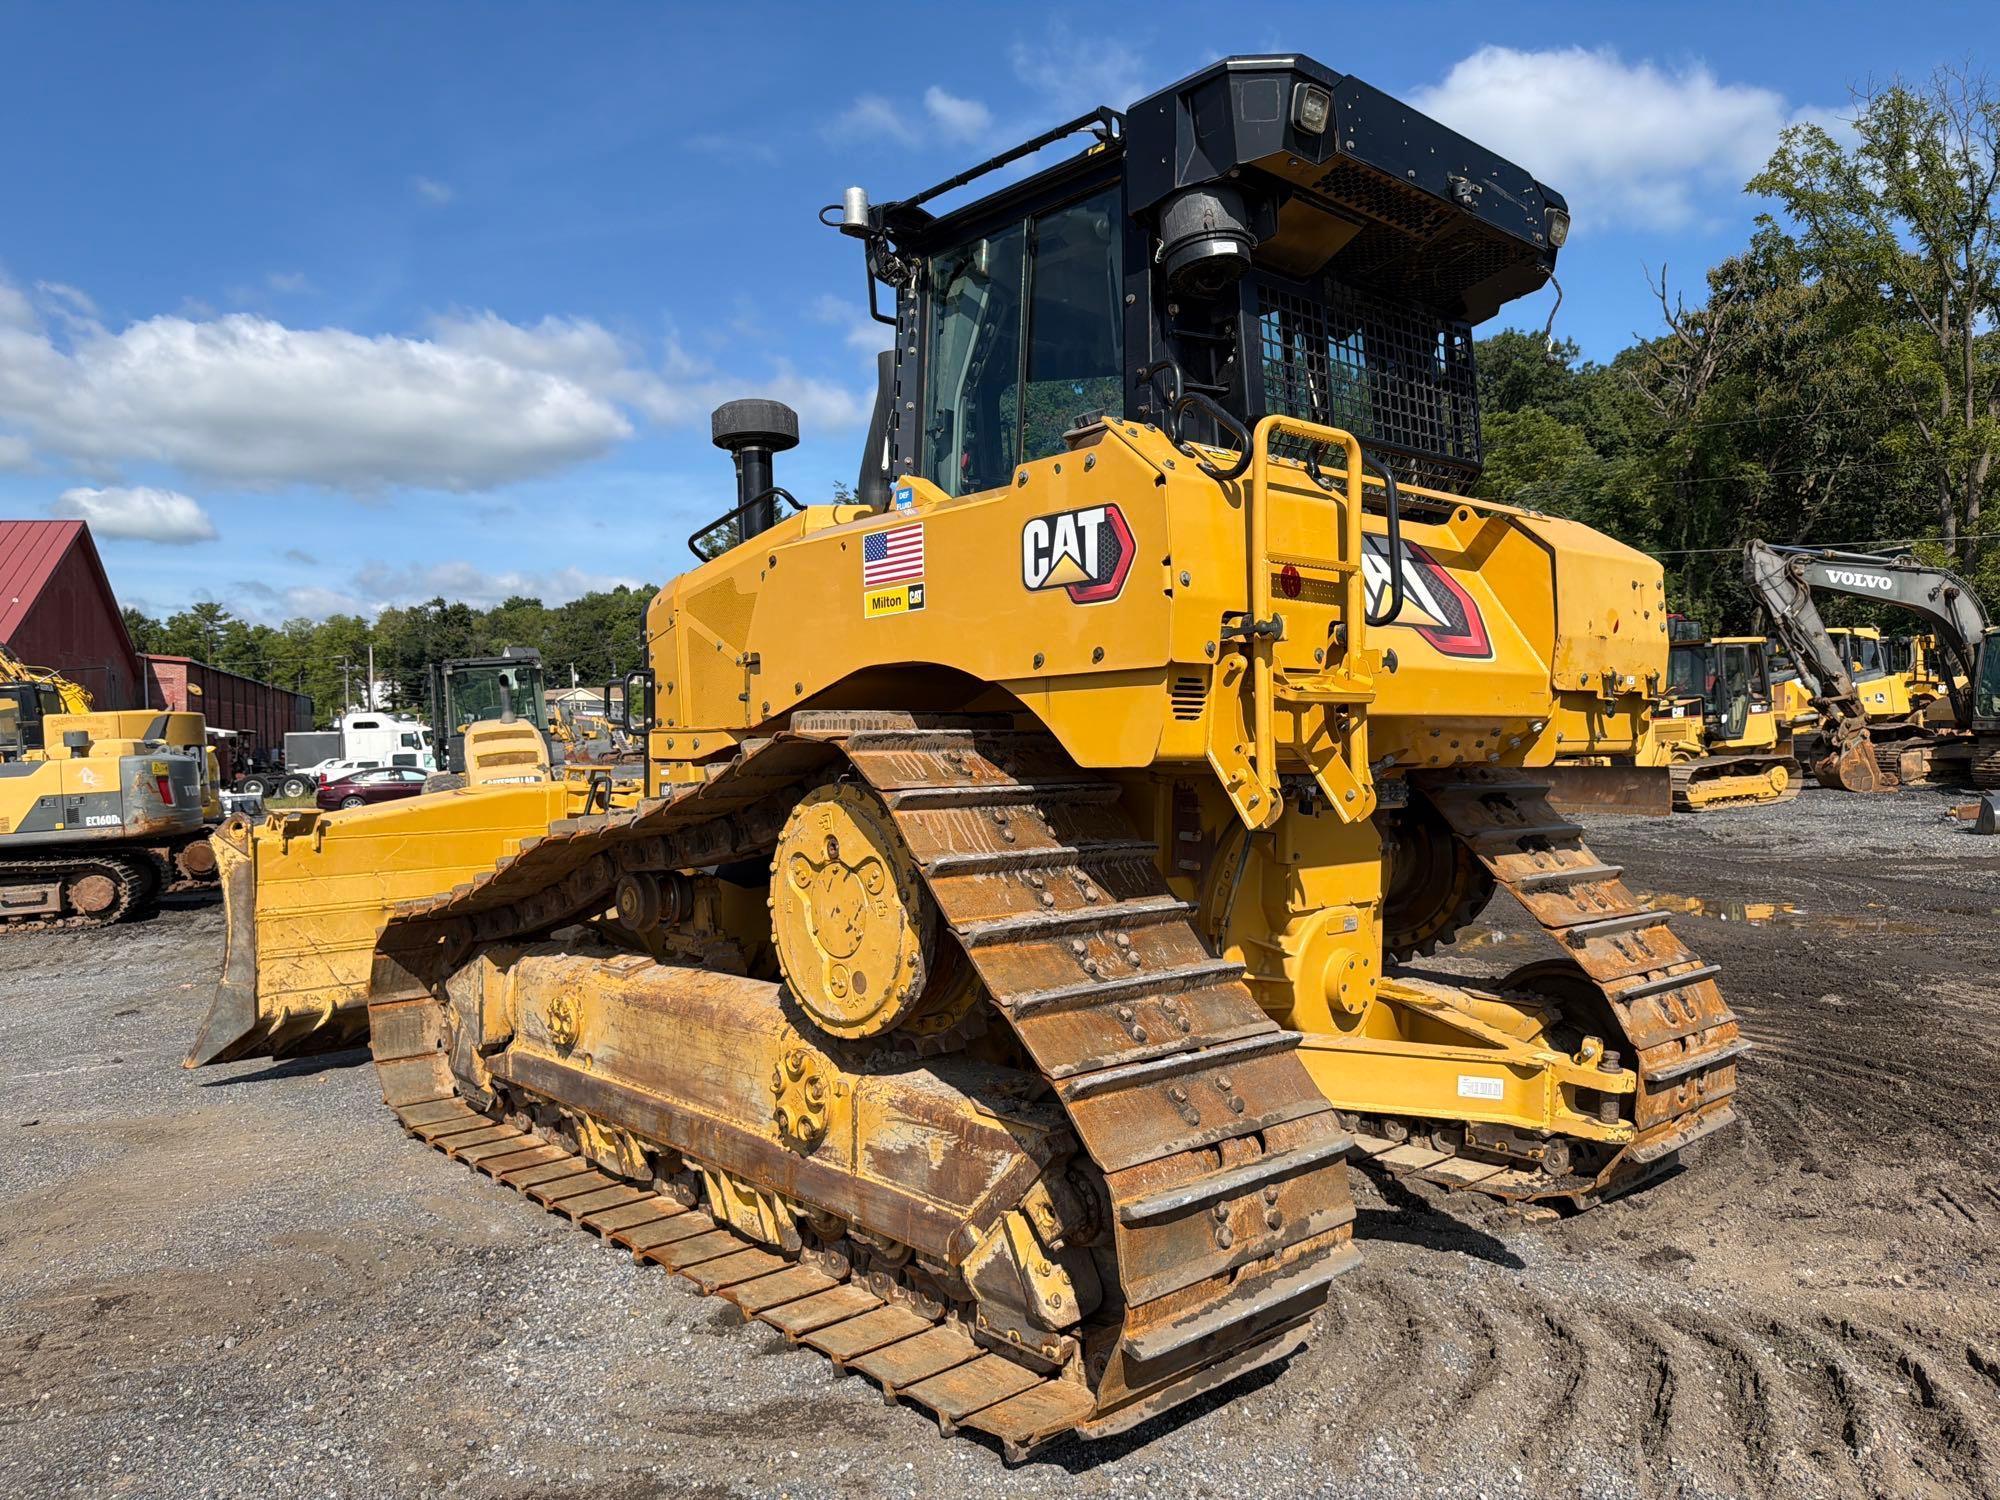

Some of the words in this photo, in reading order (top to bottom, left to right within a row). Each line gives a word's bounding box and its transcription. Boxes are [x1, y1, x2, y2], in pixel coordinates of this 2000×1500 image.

[899, 491, 909, 499] DEF
[896, 502, 912, 510] FLUID
[1023, 507, 1105, 589] CAT
[1361, 534, 1452, 627] AT
[1825, 569, 1893, 590] VOLVO
[872, 596, 902, 610] Milton
[909, 590, 922, 604] CAT
